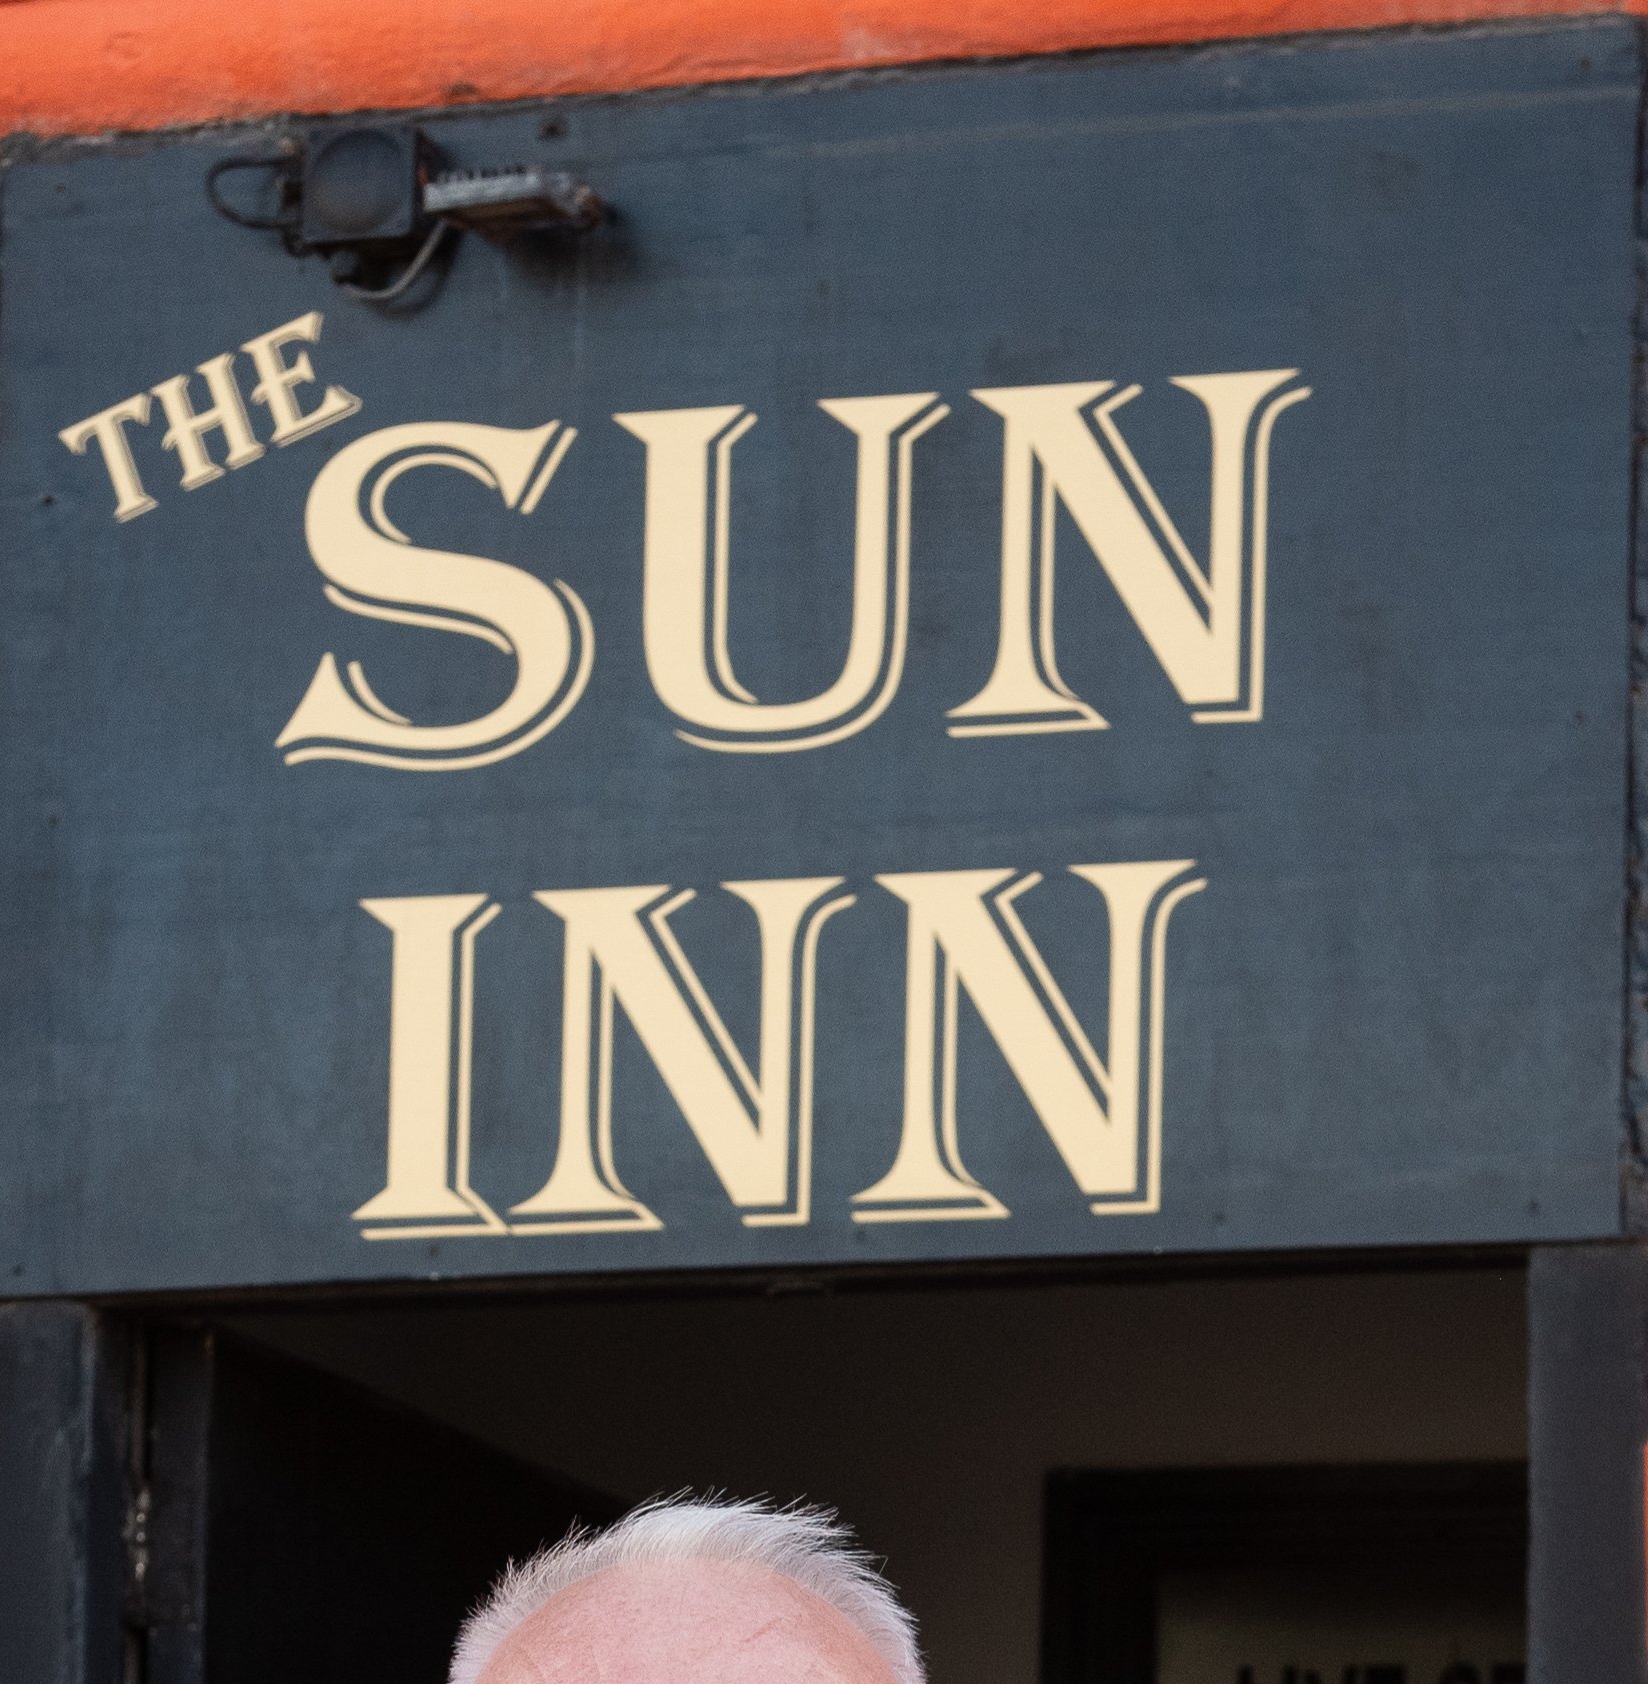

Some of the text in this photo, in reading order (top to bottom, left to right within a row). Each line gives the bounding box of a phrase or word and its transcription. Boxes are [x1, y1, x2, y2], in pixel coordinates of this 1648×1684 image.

[60, 310, 1314, 772] THE SUN
[352, 857, 1208, 1240] INN
